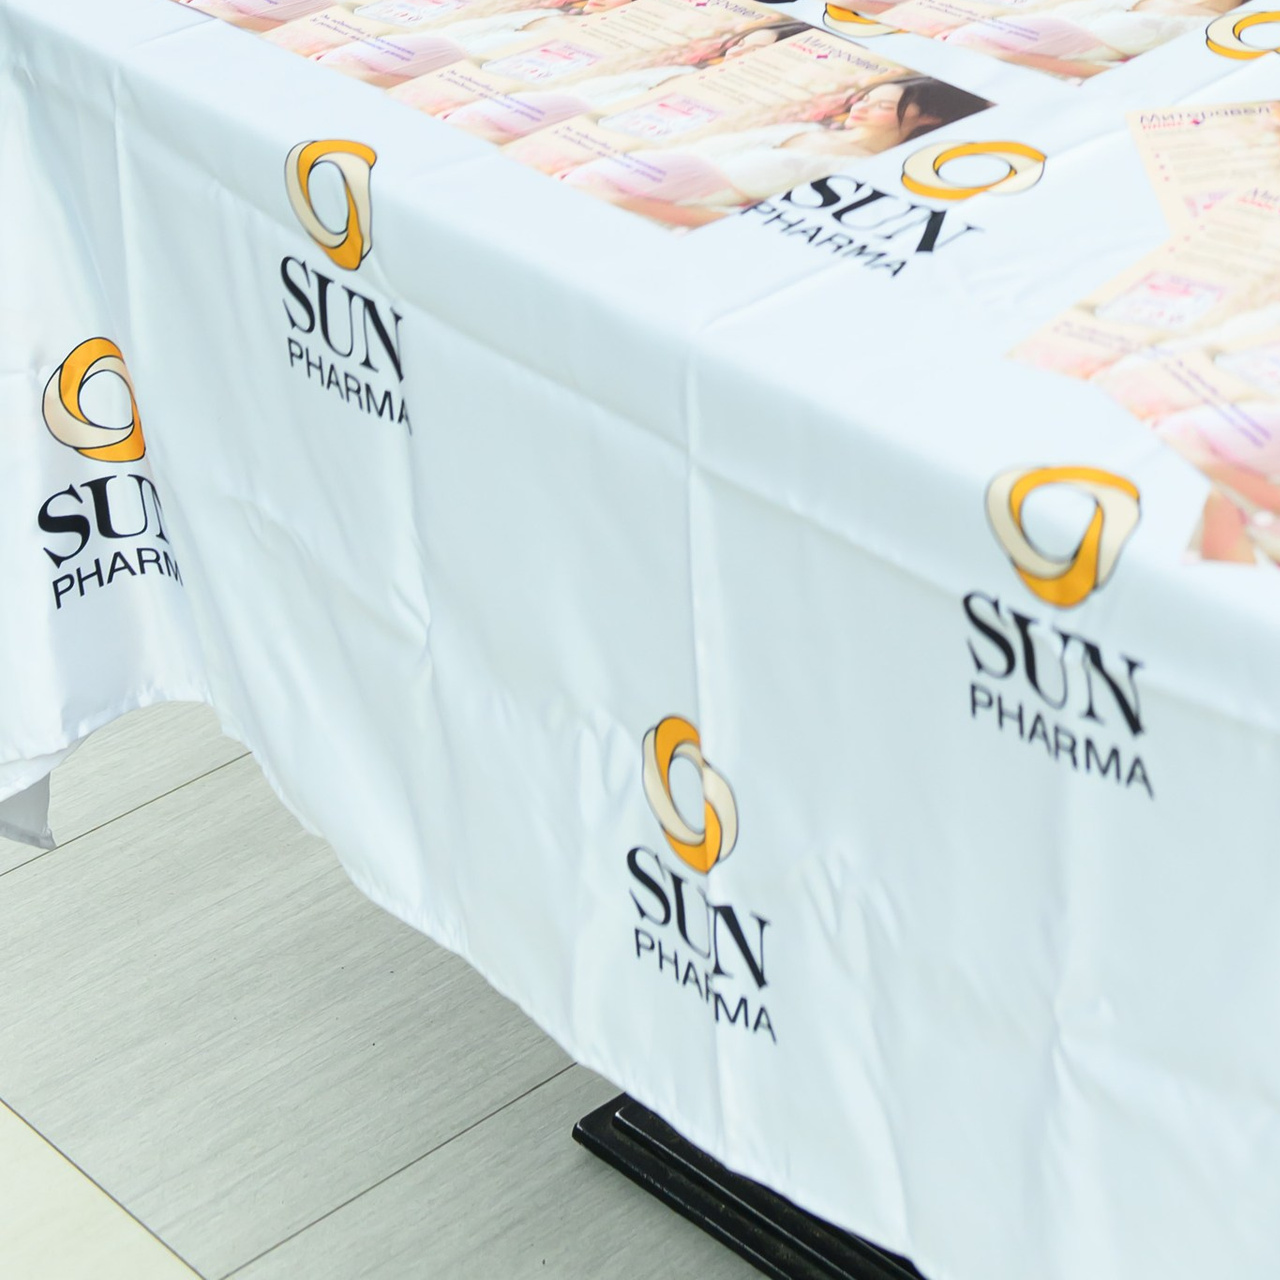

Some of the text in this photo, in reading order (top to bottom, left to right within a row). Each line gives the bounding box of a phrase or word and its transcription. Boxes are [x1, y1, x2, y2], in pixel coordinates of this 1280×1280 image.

[741, 201, 908, 279] PHARMA
[781, 174, 984, 254] SUN
[280, 255, 404, 381] SUN
[287, 336, 412, 436] PHARMA
[962, 590, 1146, 738] SUN
[969, 682, 1155, 801] PHARMA
[626, 845, 772, 990] SUN
[633, 927, 778, 1045] PHARMA
